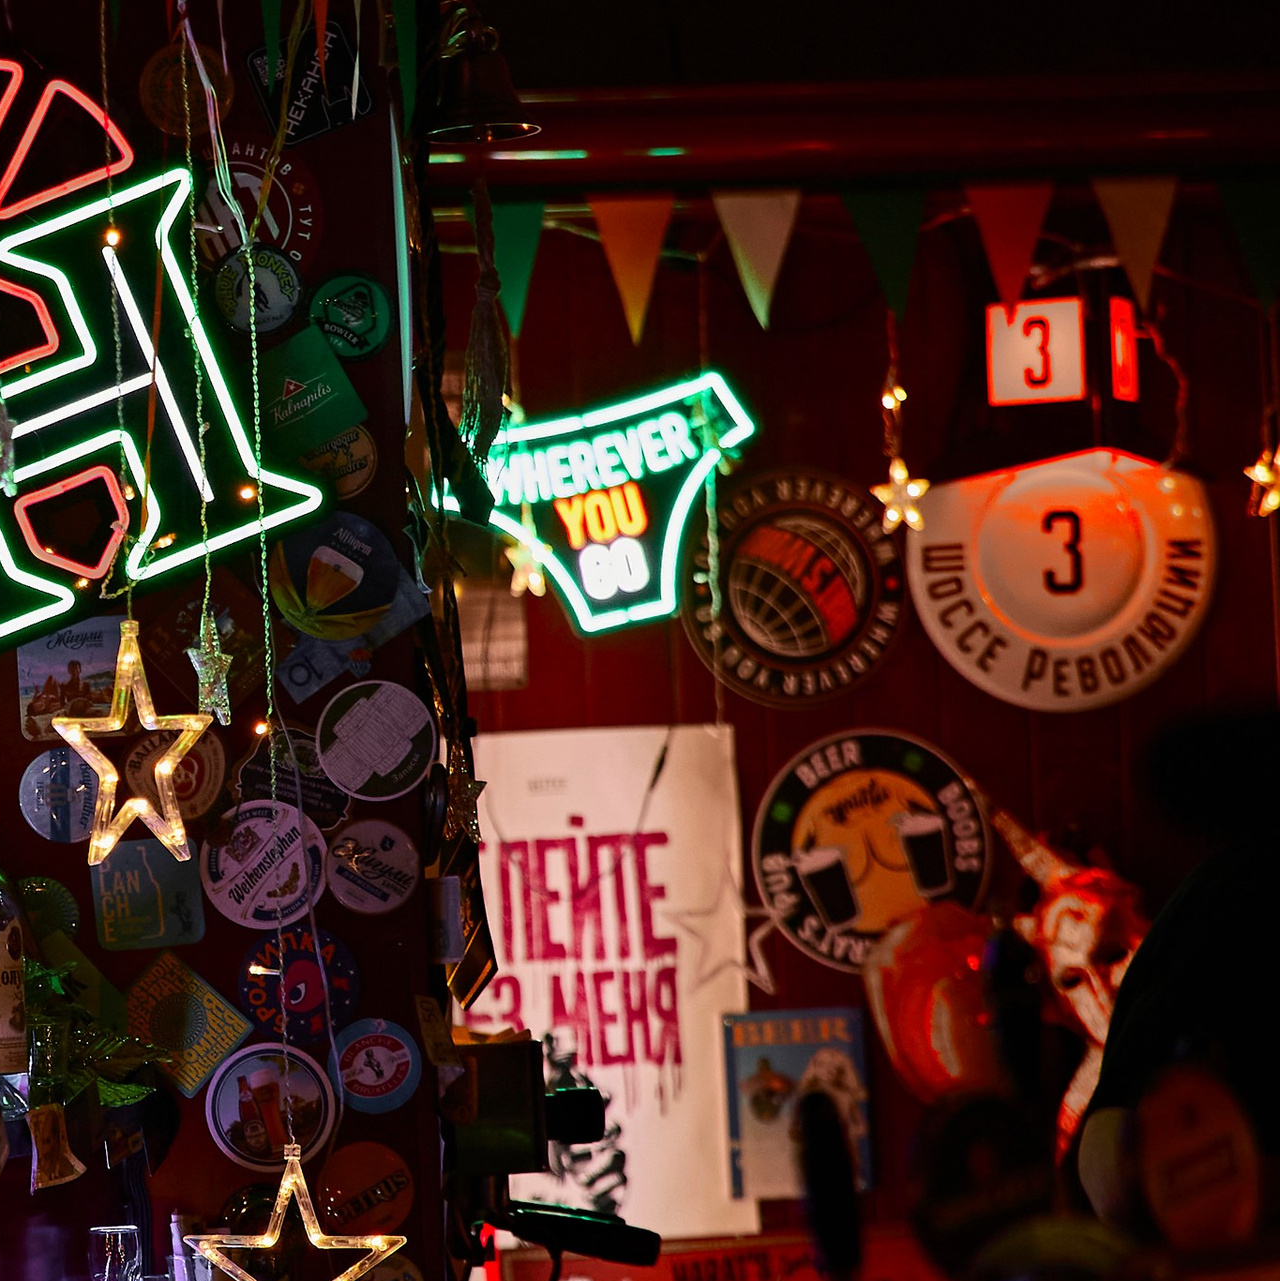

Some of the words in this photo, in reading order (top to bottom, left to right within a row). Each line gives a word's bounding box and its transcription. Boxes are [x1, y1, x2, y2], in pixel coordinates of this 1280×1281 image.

[323, 322, 359, 346] BOWLER
[1021, 317, 1052, 389] 3
[270, 382, 332, 425] Kalnapilis
[486, 411, 697, 507] WHEREVER
[332, 527, 373, 557] Affligem
[553, 481, 648, 551] YOU
[1041, 509, 1083, 595] 3
[46, 628, 104, 651] Жигули
[922, 543, 1008, 675] ШОССЕ
[1021, 537, 1204, 699] РЕВОЛЮЦИИ
[78, 762, 96, 830] Bayreuther
[794, 739, 864, 790] BEER
[331, 836, 414, 881] Жигули
[934, 779, 981, 874] BOOBS
[228, 825, 302, 906] Weihenstephan
[500, 816, 677, 962] ПЕЙТЕ
[552, 966, 681, 1065] МЕНЯ
[343, 1038, 394, 1064] BLANCHE
[351, 1063, 409, 1095] BRUXELLES
[333, 1170, 409, 1223] PETRUS
